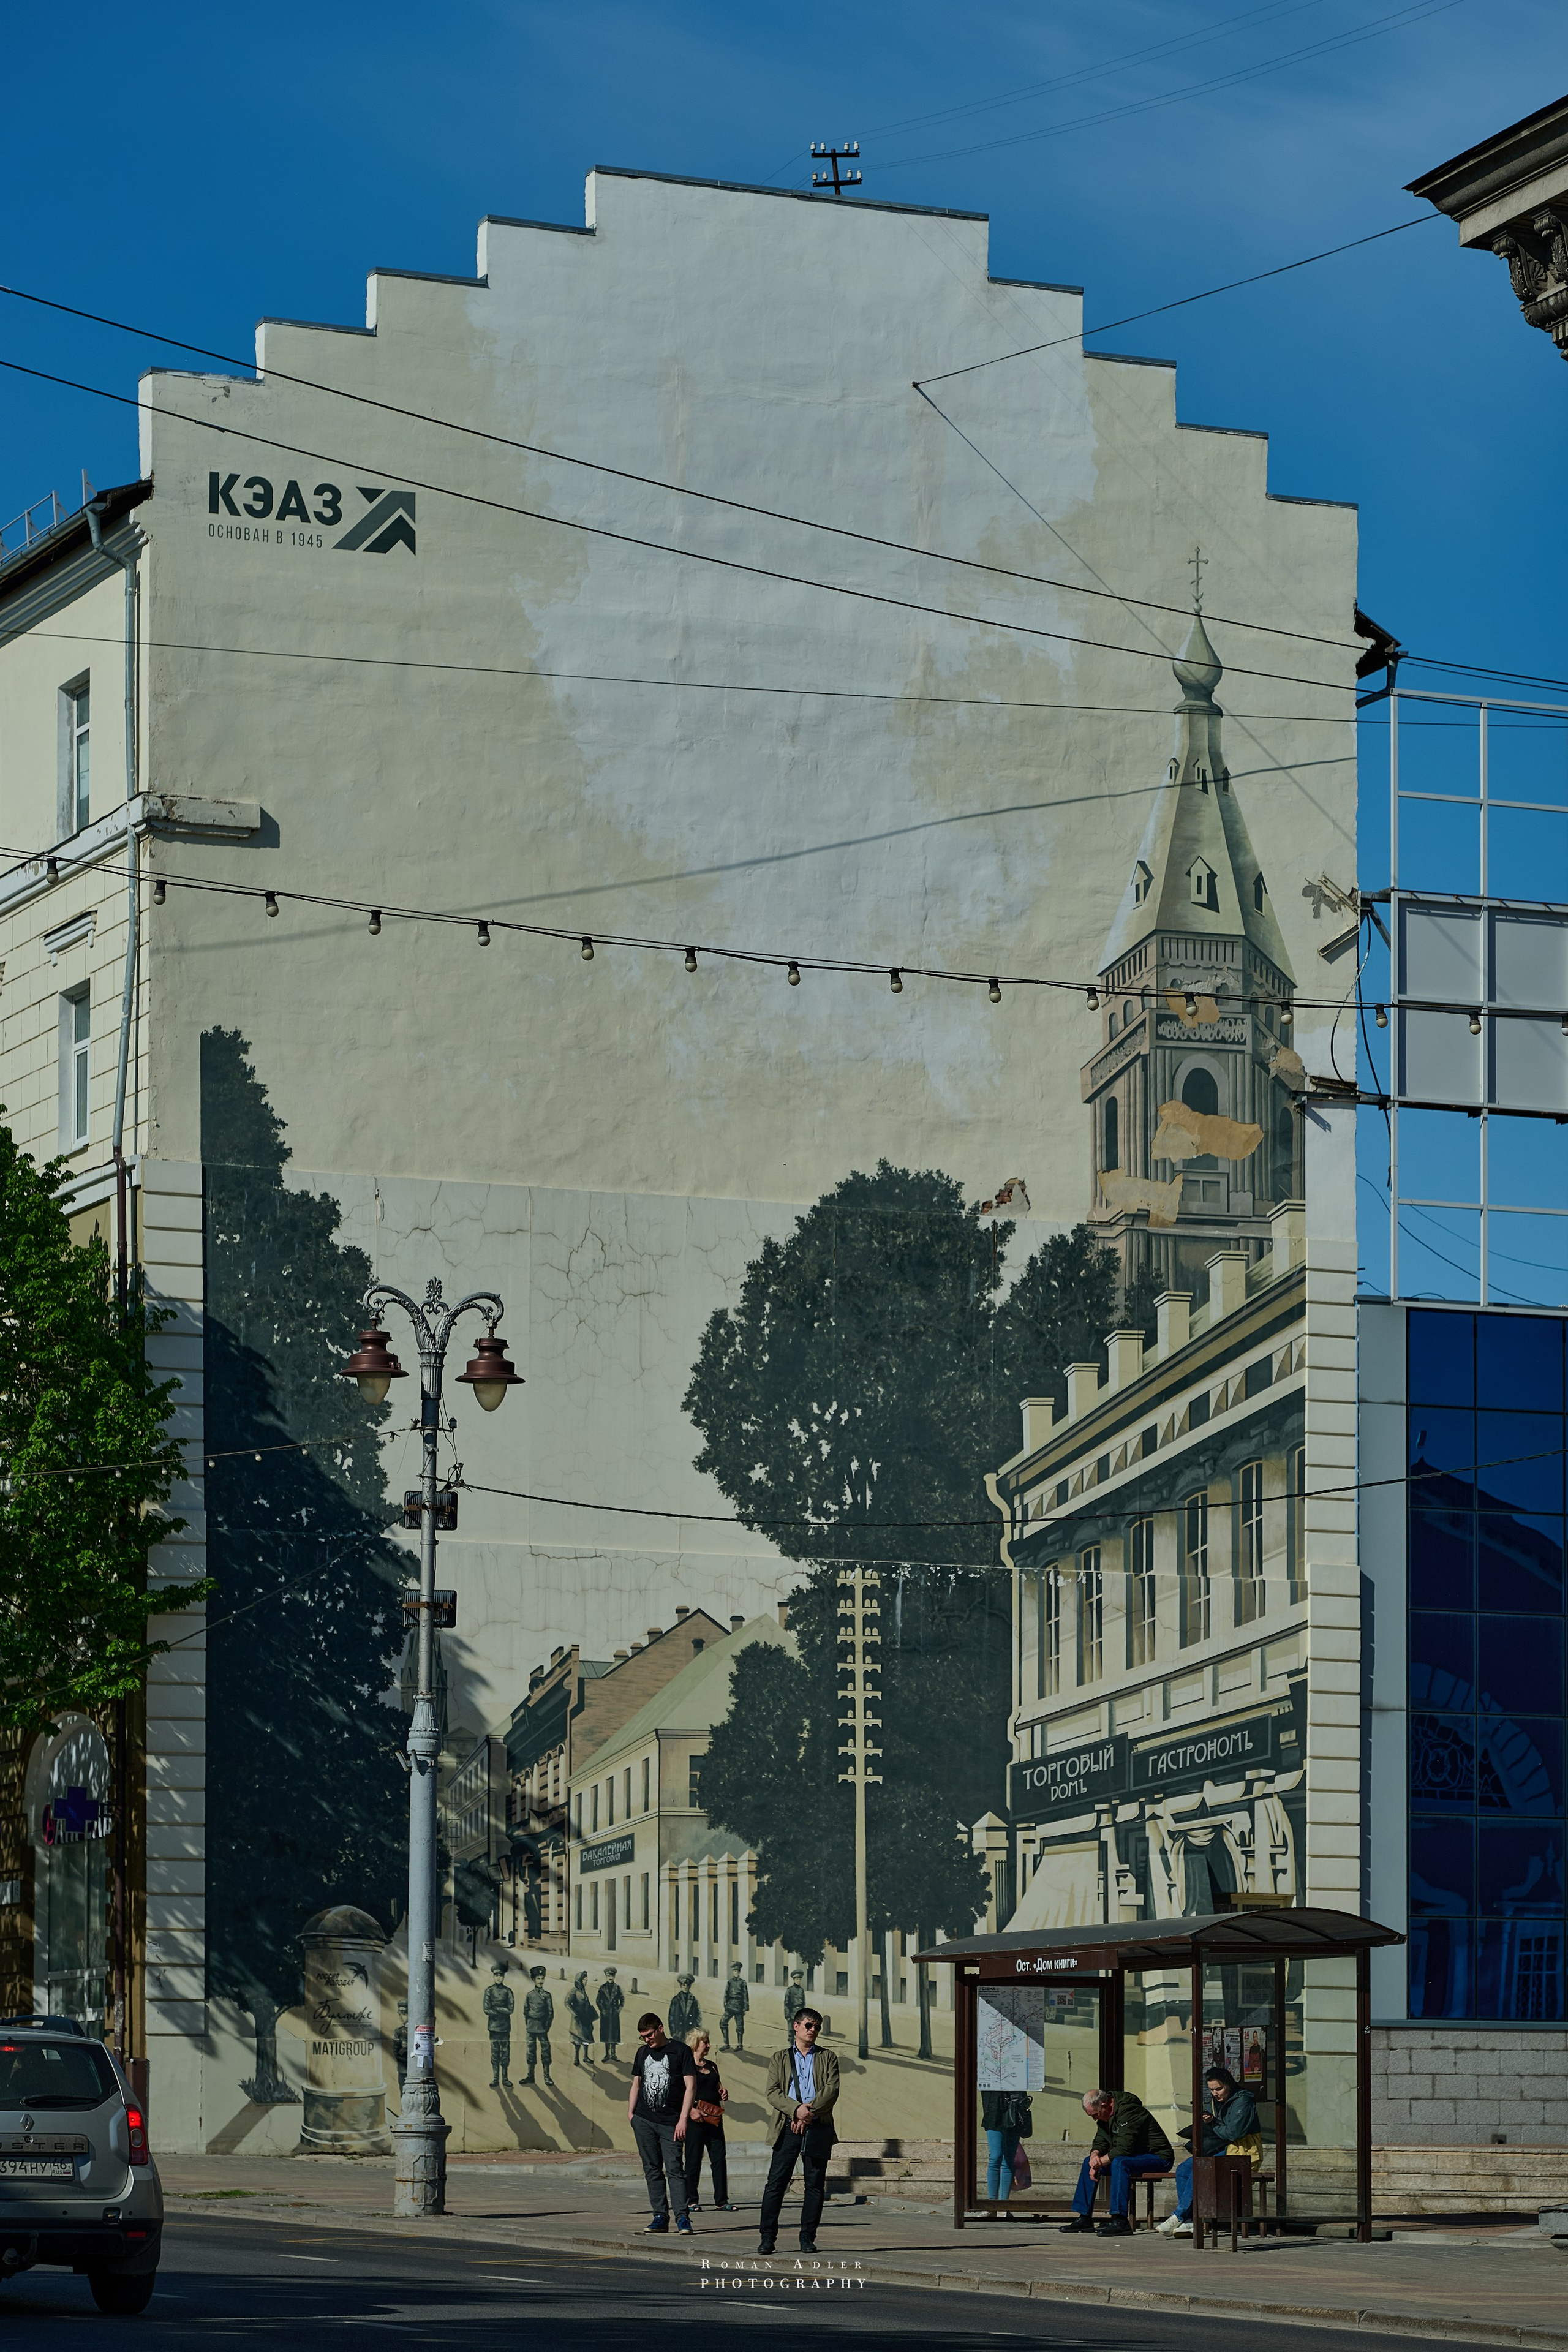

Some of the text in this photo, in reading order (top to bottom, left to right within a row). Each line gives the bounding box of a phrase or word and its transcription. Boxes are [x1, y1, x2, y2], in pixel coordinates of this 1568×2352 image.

[208, 471, 342, 526] КЭАЗ
[208, 523, 323, 548] ОСНОВАН В 1945
[1148, 1730, 1254, 1777] ГАСТРОНОМЪ
[1022, 1743, 1115, 1790] ТОРГОВЫЙ
[582, 1839, 632, 1862] БАКАЛЕЙНАЯ
[592, 1853, 621, 1867] ТОРГОВЛЯ
[1016, 1958, 1078, 1972] Ост. «Дом книги»
[312, 2041, 374, 2056] MATIGROUP
[0, 2142, 85, 2150] STER
